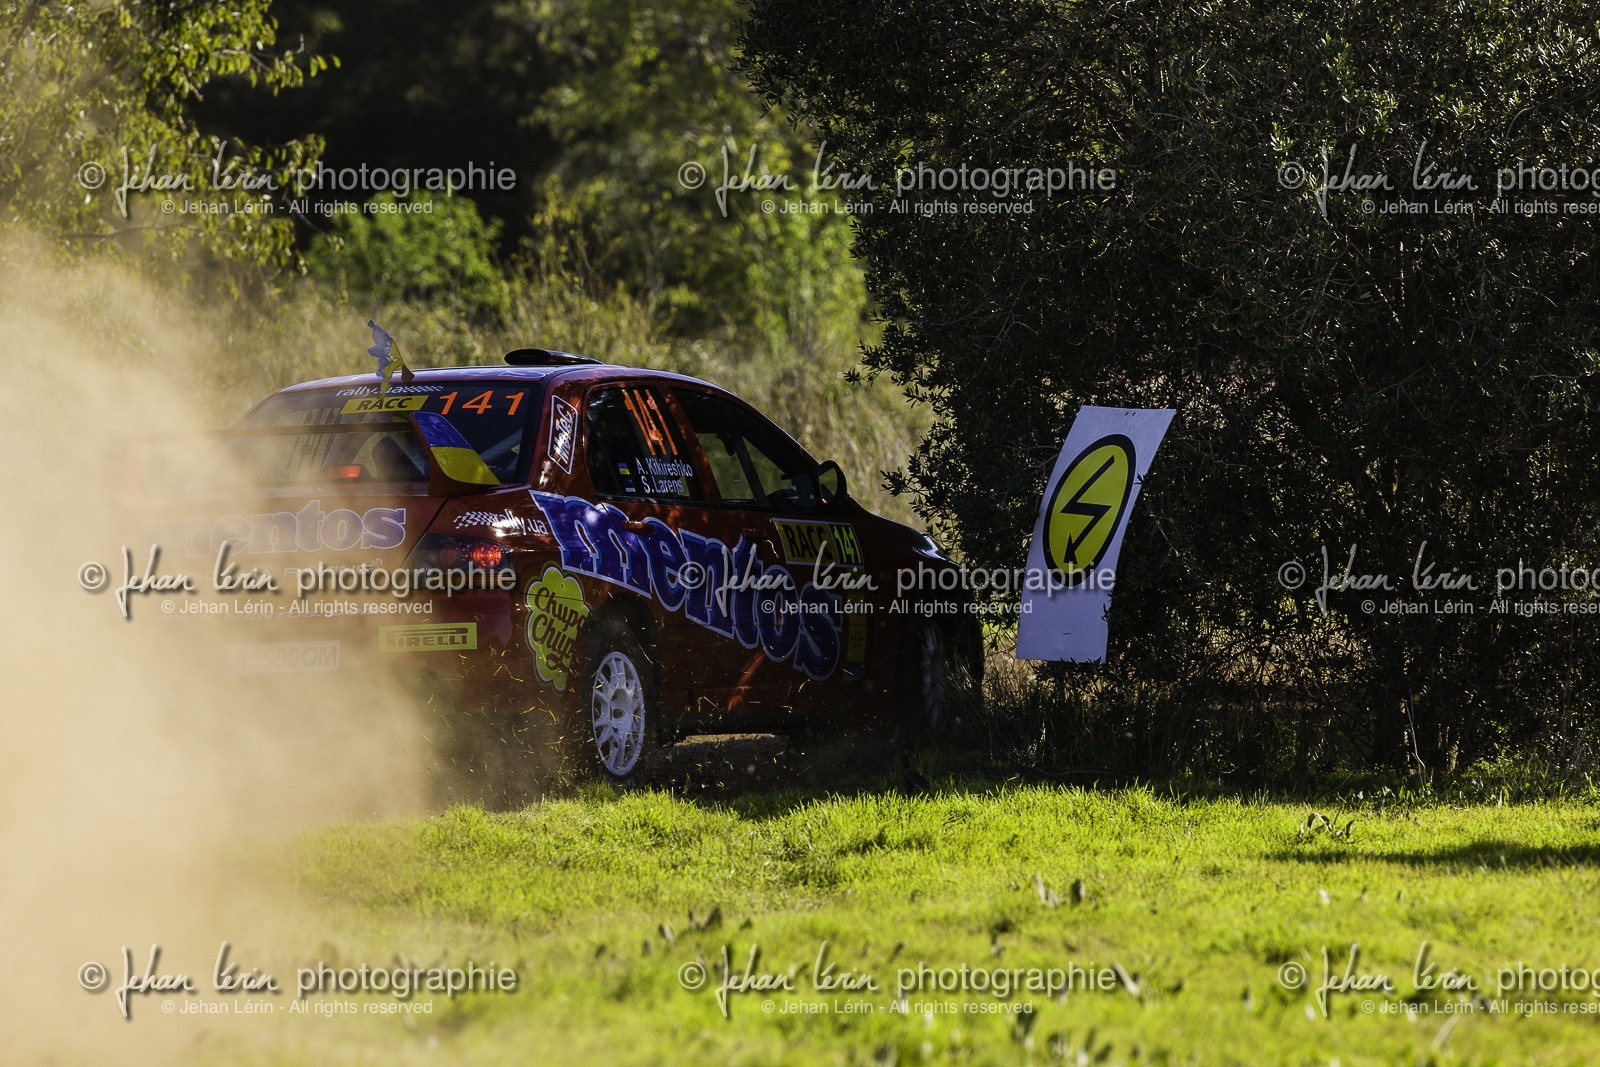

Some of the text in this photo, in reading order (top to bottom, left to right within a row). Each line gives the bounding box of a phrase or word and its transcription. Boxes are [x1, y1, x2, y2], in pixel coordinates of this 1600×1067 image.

[356, 398, 412, 411] RACC
[439, 390, 525, 415] 141
[621, 389, 678, 456] 141
[781, 523, 862, 565] RACC 141
[528, 489, 843, 682] mentos
[387, 627, 469, 648] PIRELLI
